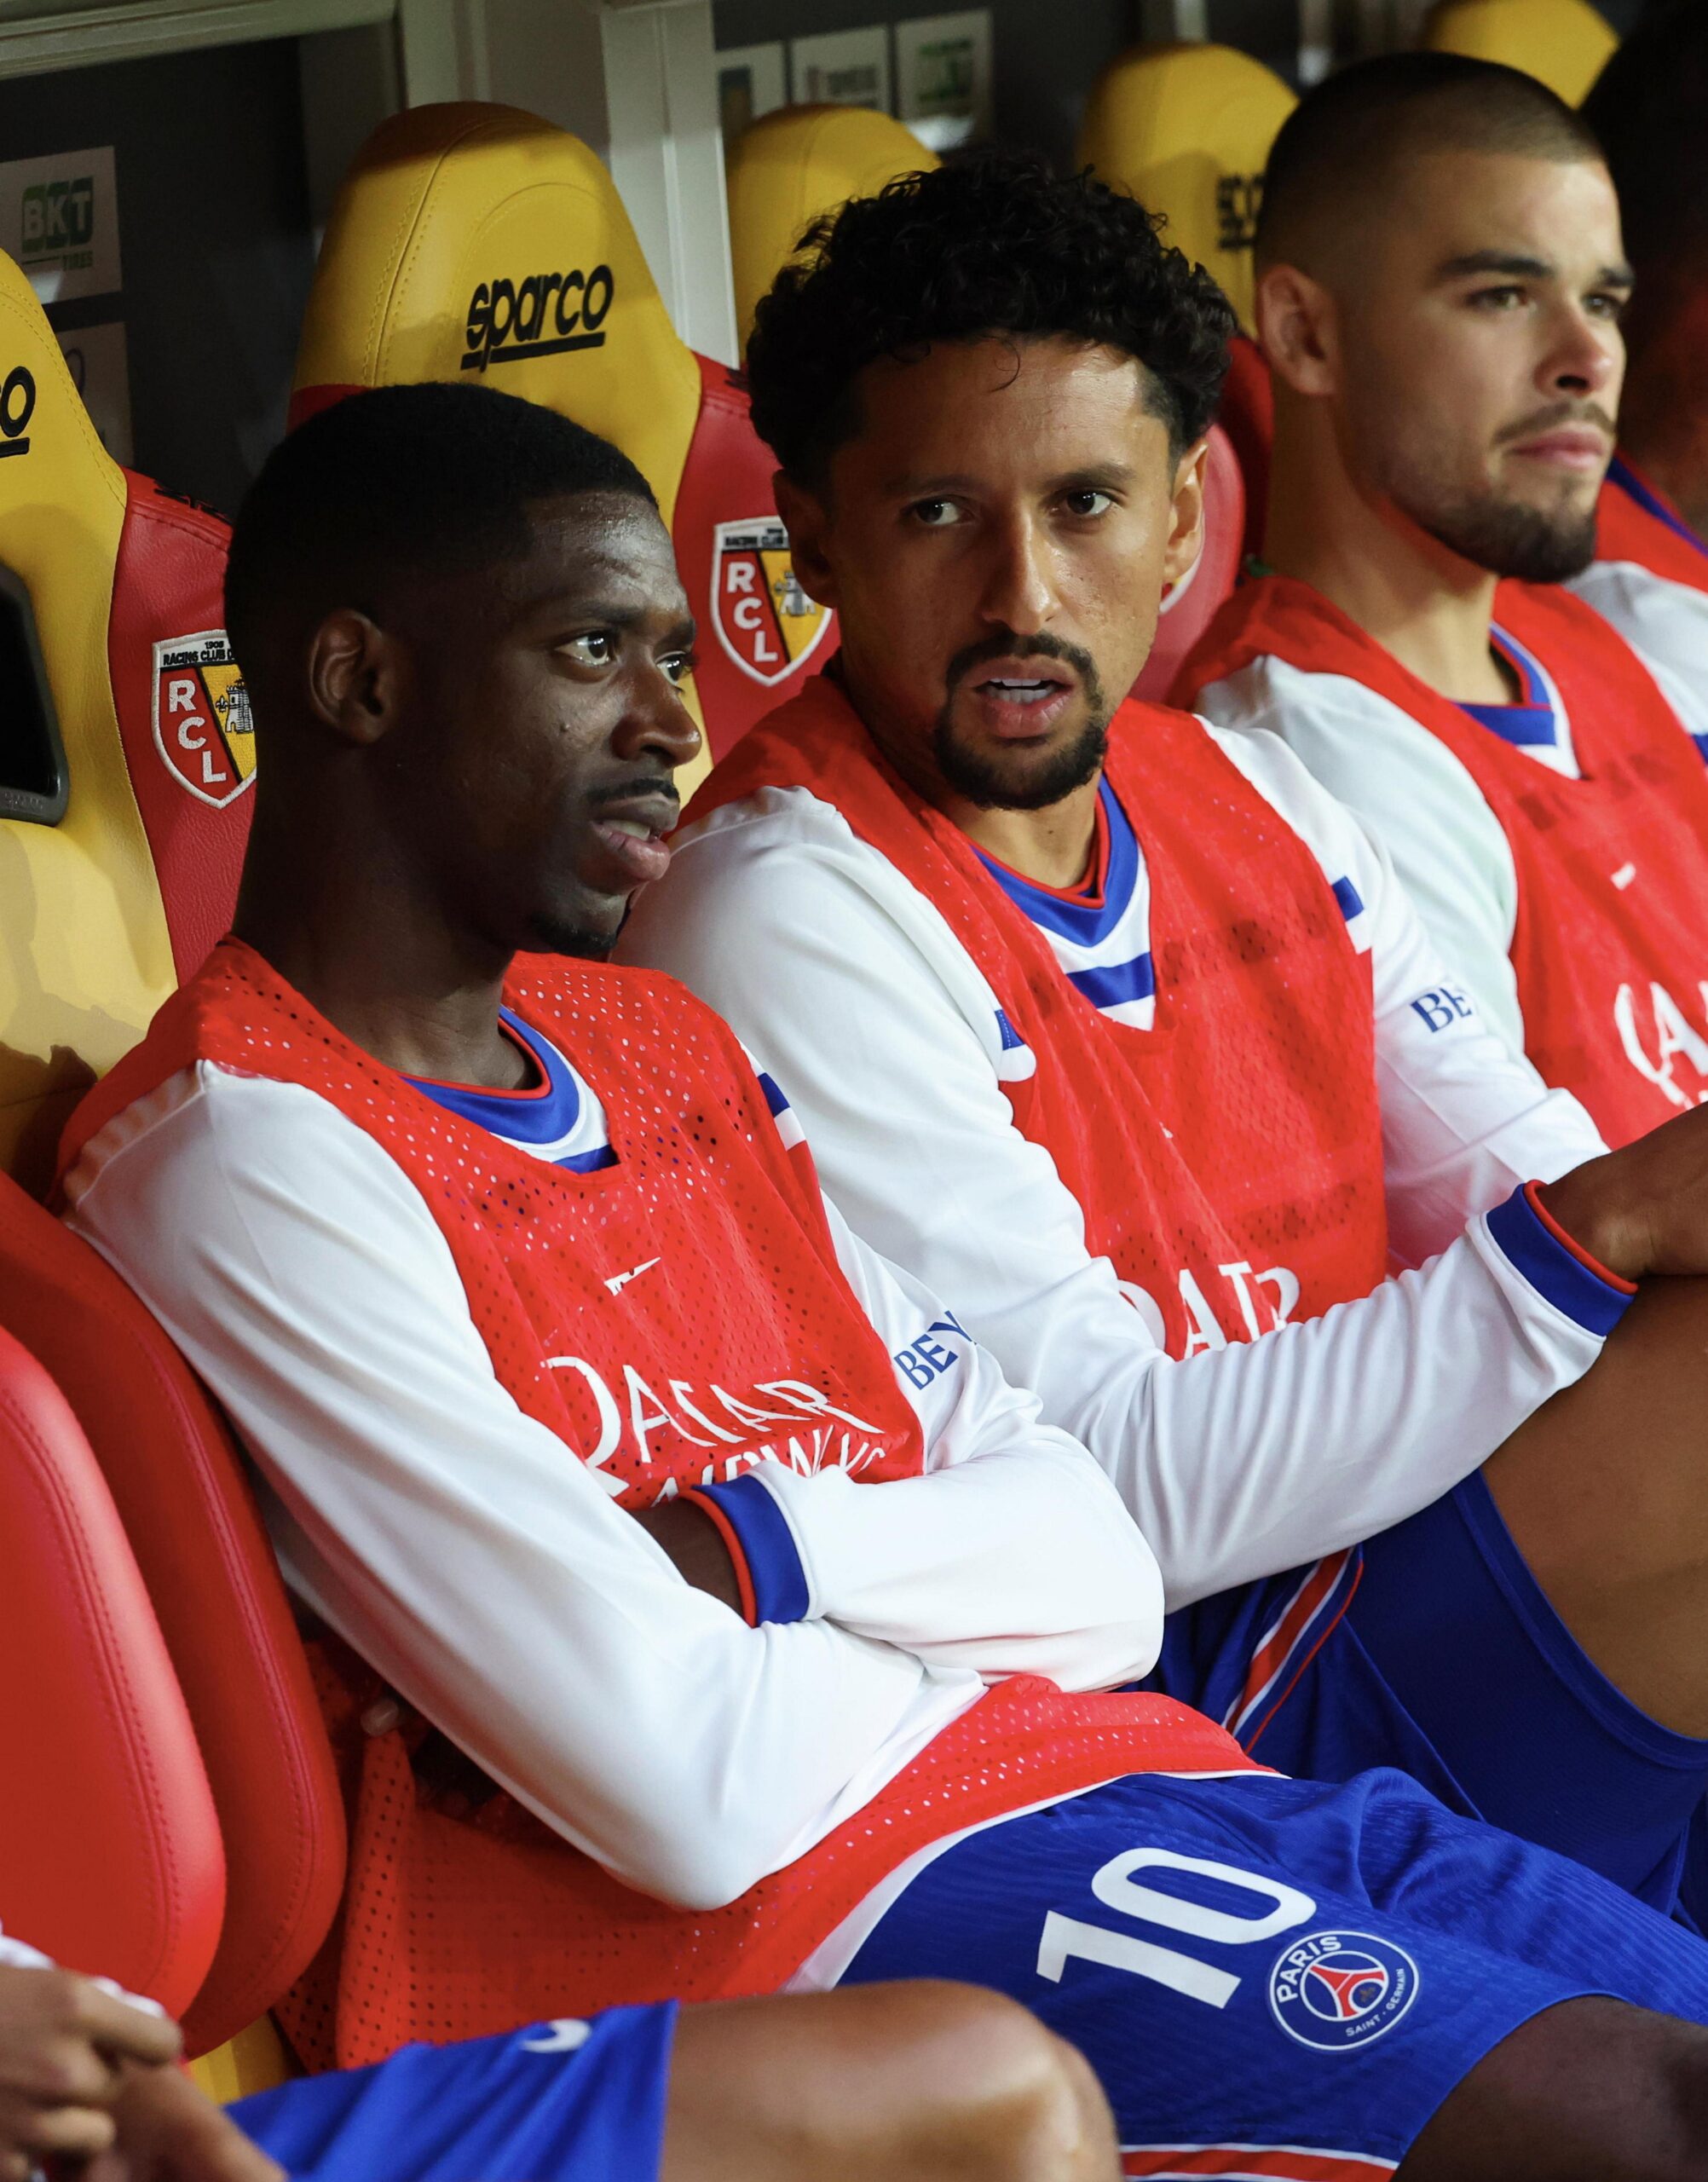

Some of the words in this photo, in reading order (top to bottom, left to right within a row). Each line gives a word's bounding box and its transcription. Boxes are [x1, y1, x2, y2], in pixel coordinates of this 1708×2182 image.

[22, 184, 92, 245] BKT
[466, 264, 614, 372] sparco
[727, 562, 778, 662] RCL
[163, 650, 199, 666] RACING
[200, 649, 225, 661] CLUB
[169, 679, 227, 783] RCL
[1036, 1847, 1317, 2009] 10
[1277, 1937, 1342, 2003] PARIS
[1346, 2014, 1381, 2036] SAINT
[1386, 1968, 1406, 2010] GERMAIN
